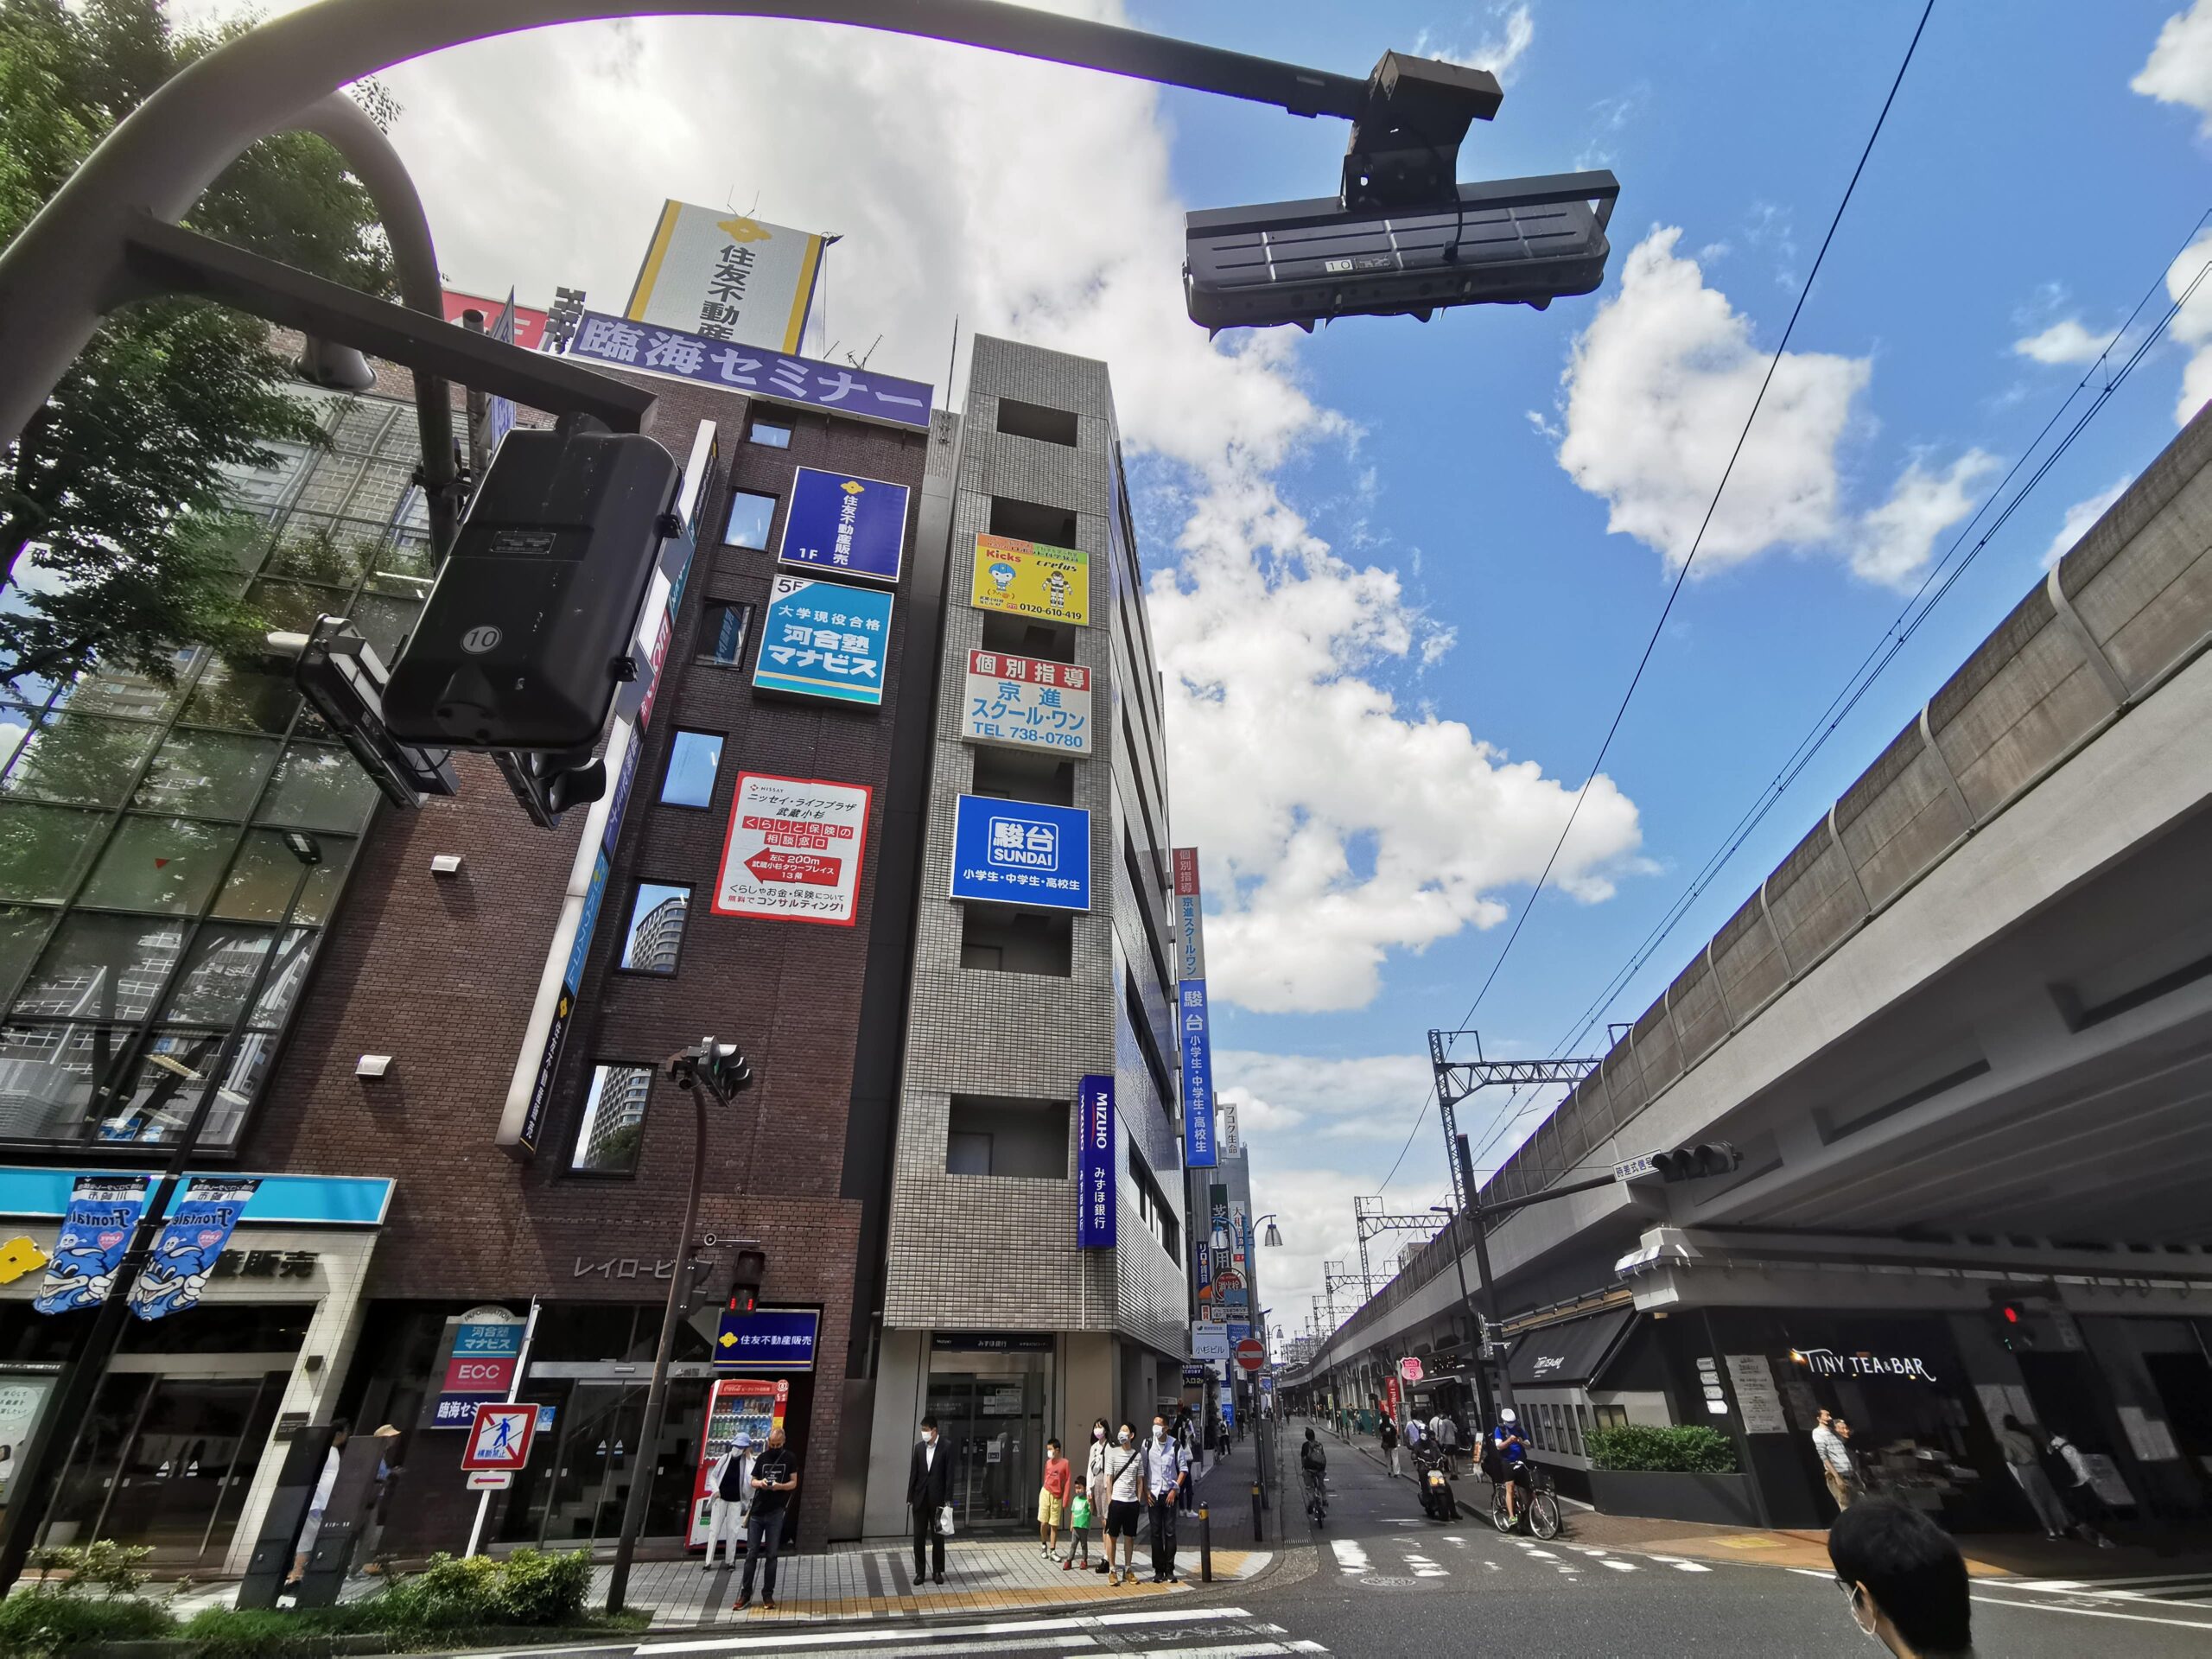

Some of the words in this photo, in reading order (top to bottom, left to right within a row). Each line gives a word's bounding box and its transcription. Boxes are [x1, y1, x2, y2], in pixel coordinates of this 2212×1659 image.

[578, 319, 923, 409] 臨海セミナー
[832, 494, 858, 565] 住友不動産販売
[798, 548, 818, 561] 1F
[986, 549, 1021, 563] Kicks
[778, 580, 804, 593] 5F
[779, 605, 881, 632] 大学現役合格
[1020, 603, 1082, 620] 0120-610-419
[470, 631, 497, 646] 10
[782, 624, 869, 655] 河合塾
[768, 645, 877, 679] マナビス
[976, 653, 1084, 688] 個別指導
[997, 682, 1062, 709] 京進
[971, 698, 1085, 731] スクール・ワン
[973, 721, 1005, 737] TEL
[1009, 727, 1083, 747] 738-0780
[747, 793, 857, 811] ニッセイ・ライフプラザ
[776, 807, 825, 819] 武蔵小杉
[746, 817, 851, 836] くらしと保険の
[766, 834, 825, 848] 相談窓口
[993, 822, 1054, 852] 駿台
[787, 855, 820, 865] 200m
[994, 849, 1052, 866] SUNDAI
[752, 861, 835, 874] 武蔵小杉タワープレイス
[1179, 849, 1192, 893] 個別指導
[963, 868, 1080, 891] 小学生・中学生・高校生
[730, 885, 844, 902] くらしやお金・保険について
[1184, 990, 1203, 1031] 駿台
[1190, 1035, 1207, 1153] 小学生・中学生・高校生
[1096, 1092, 1108, 1149] MIZUHO
[1225, 1106, 1237, 1154] フコク生命
[1095, 1167, 1106, 1230] みずほ銀行
[464, 1306, 512, 1322] INFORMATION
[471, 1326, 509, 1338] 河合塾
[741, 1335, 812, 1345] 住友不動産販売
[464, 1339, 510, 1349] マナビス
[1195, 1345, 1225, 1354] 小杉ビル
[1792, 1348, 1844, 1373] TINY
[458, 1364, 499, 1379] ECC
[437, 1402, 480, 1419] 臨海セミ
[477, 1447, 506, 1459] 横断禁止
